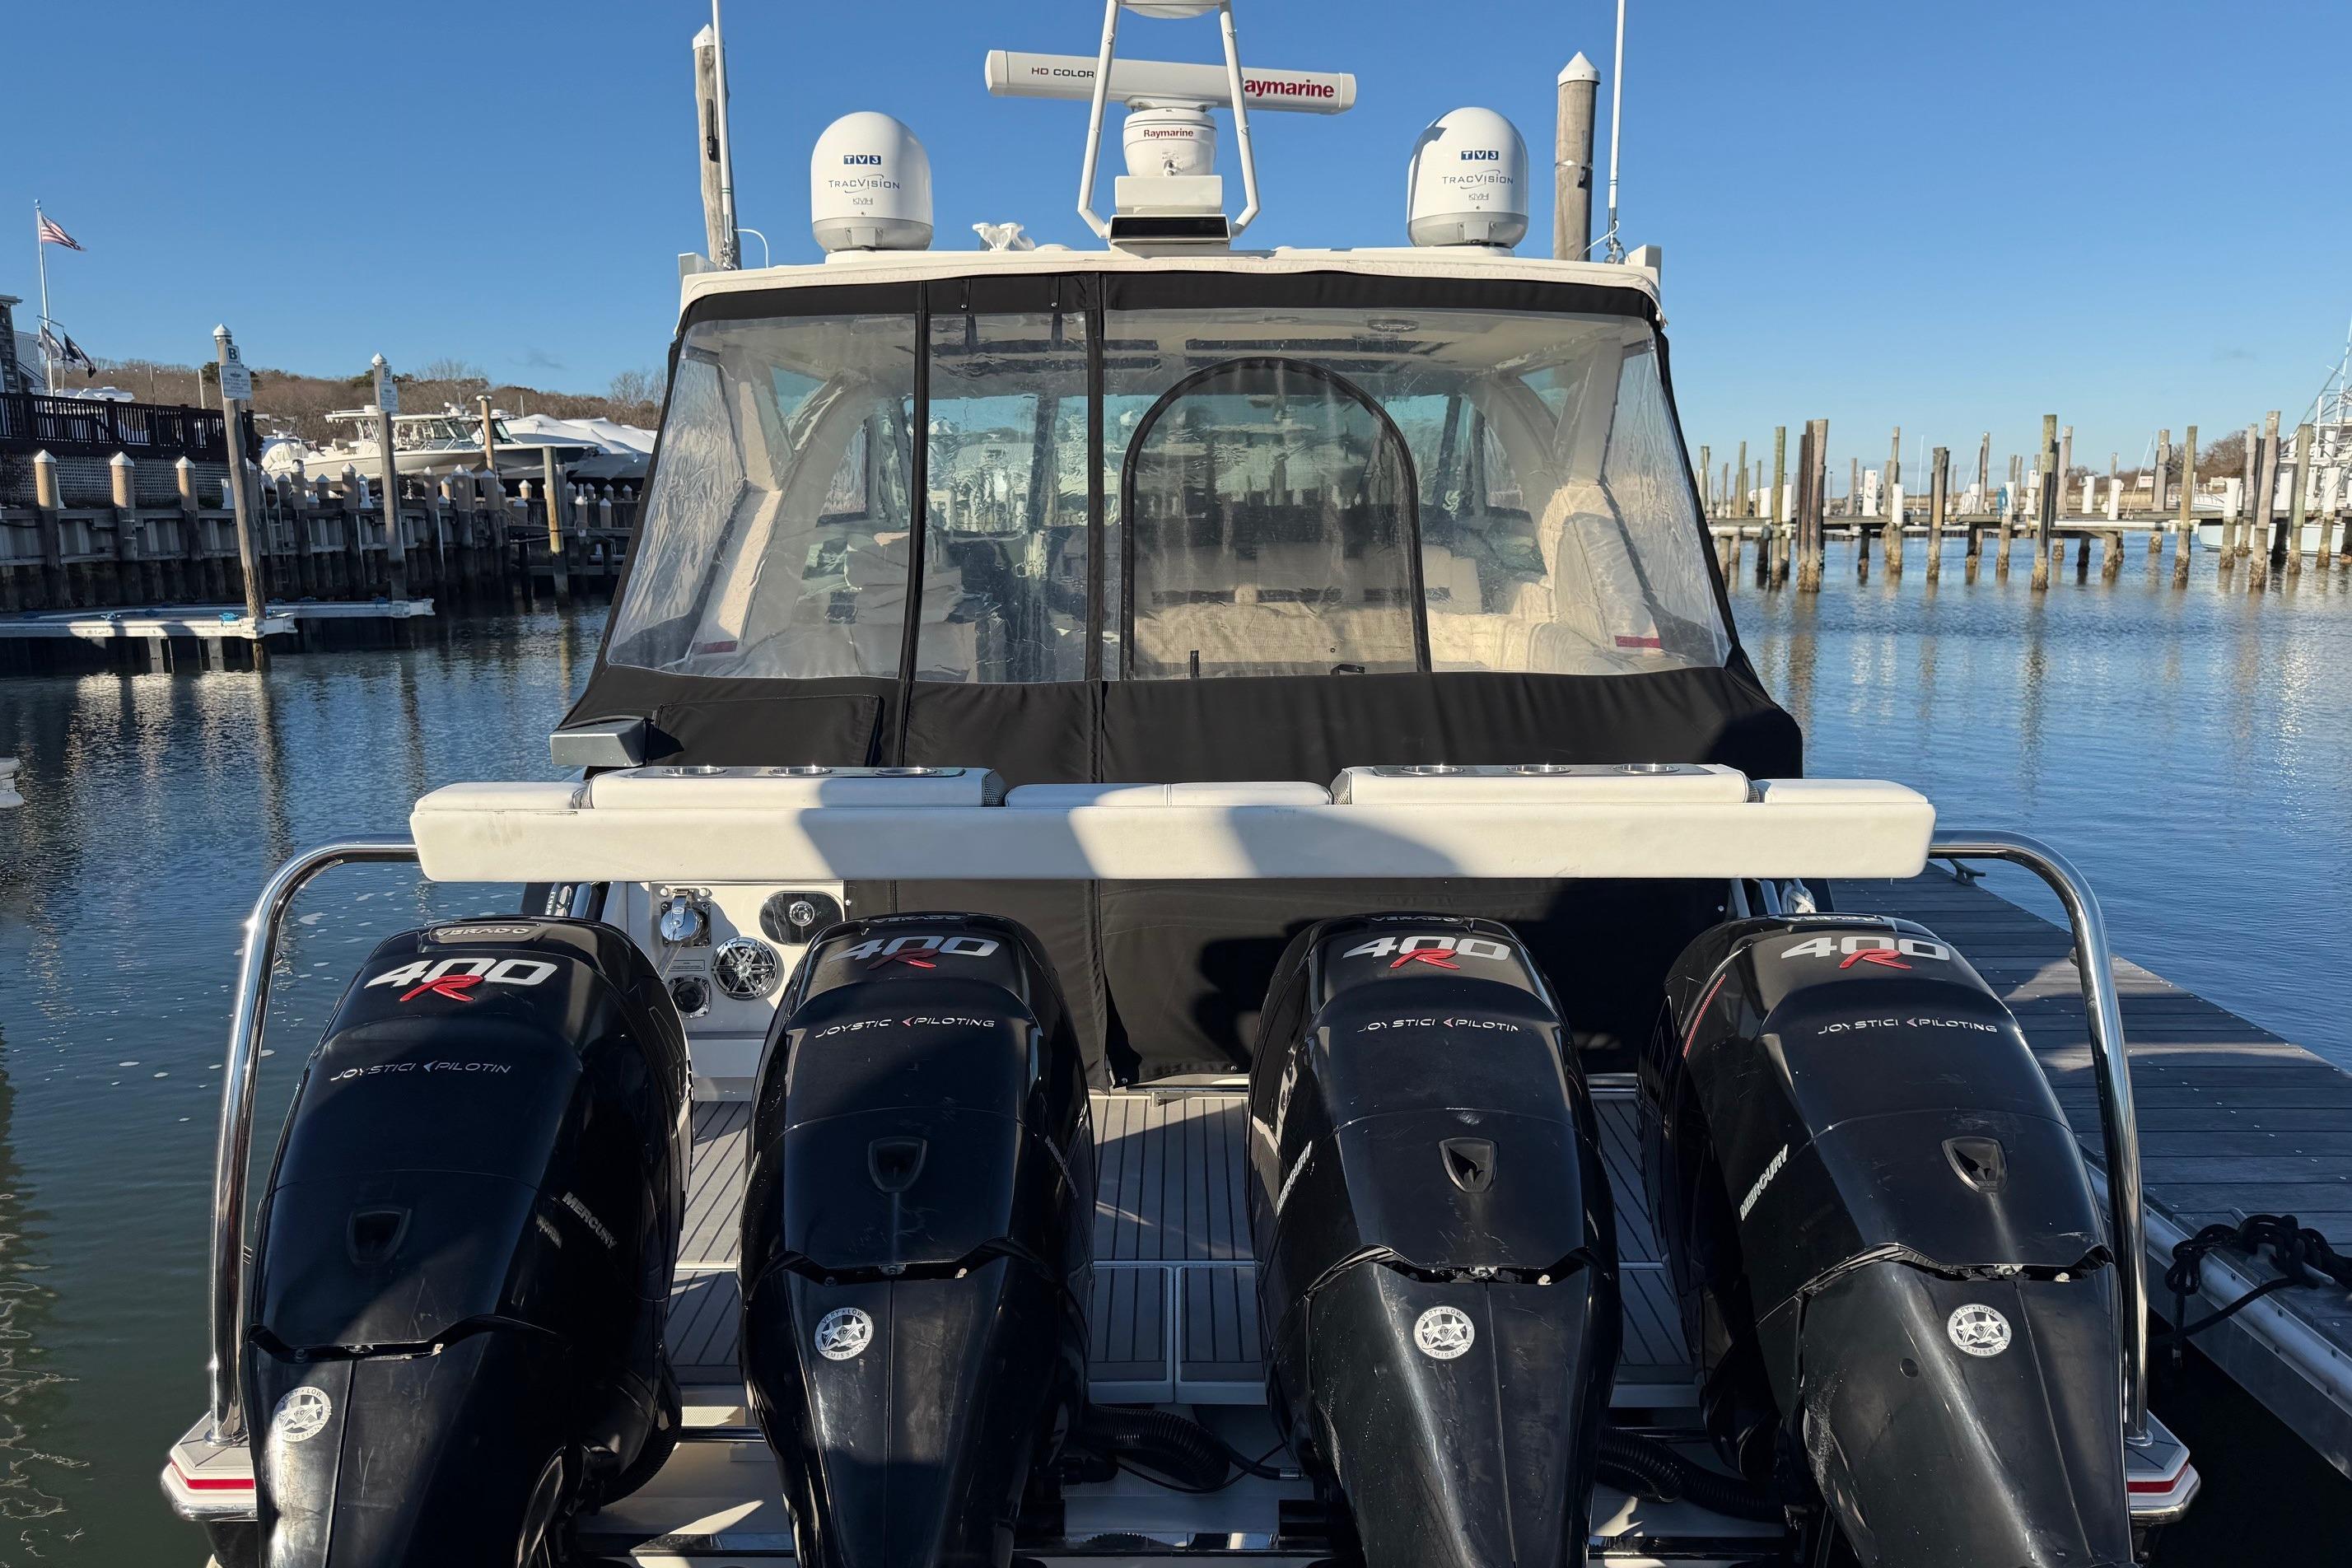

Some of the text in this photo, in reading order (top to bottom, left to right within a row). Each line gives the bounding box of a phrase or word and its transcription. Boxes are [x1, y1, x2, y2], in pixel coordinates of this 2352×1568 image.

[1053, 68, 1094, 78] COLOR
[1243, 79, 1334, 98] aymarine
[1143, 128, 1194, 138] Raymarine
[844, 155, 880, 165] TV3
[1461, 151, 1498, 160] TV3
[227, 348, 237, 359] B
[384, 367, 391, 377] B
[827, 936, 1000, 963] 400
[1342, 936, 1510, 960] 400
[1780, 936, 1949, 960] 400
[867, 948, 940, 970] R
[1390, 949, 1460, 970] R
[1839, 949, 1912, 969] R
[364, 958, 558, 988] 400
[399, 975, 484, 1001] R
[913, 1017, 995, 1028] PILOTING
[1918, 1019, 1998, 1033] PILOTING
[1739, 1144, 1788, 1221] MERCURY
[562, 1192, 618, 1249] MERCURY
[824, 1309, 863, 1323] VERY LOW
[1421, 1309, 1462, 1322] VERY LOW
[1953, 1306, 1995, 1319] VERY LOW
[826, 1345, 863, 1359] EMISSION
[306, 1388, 323, 1398] LOW
